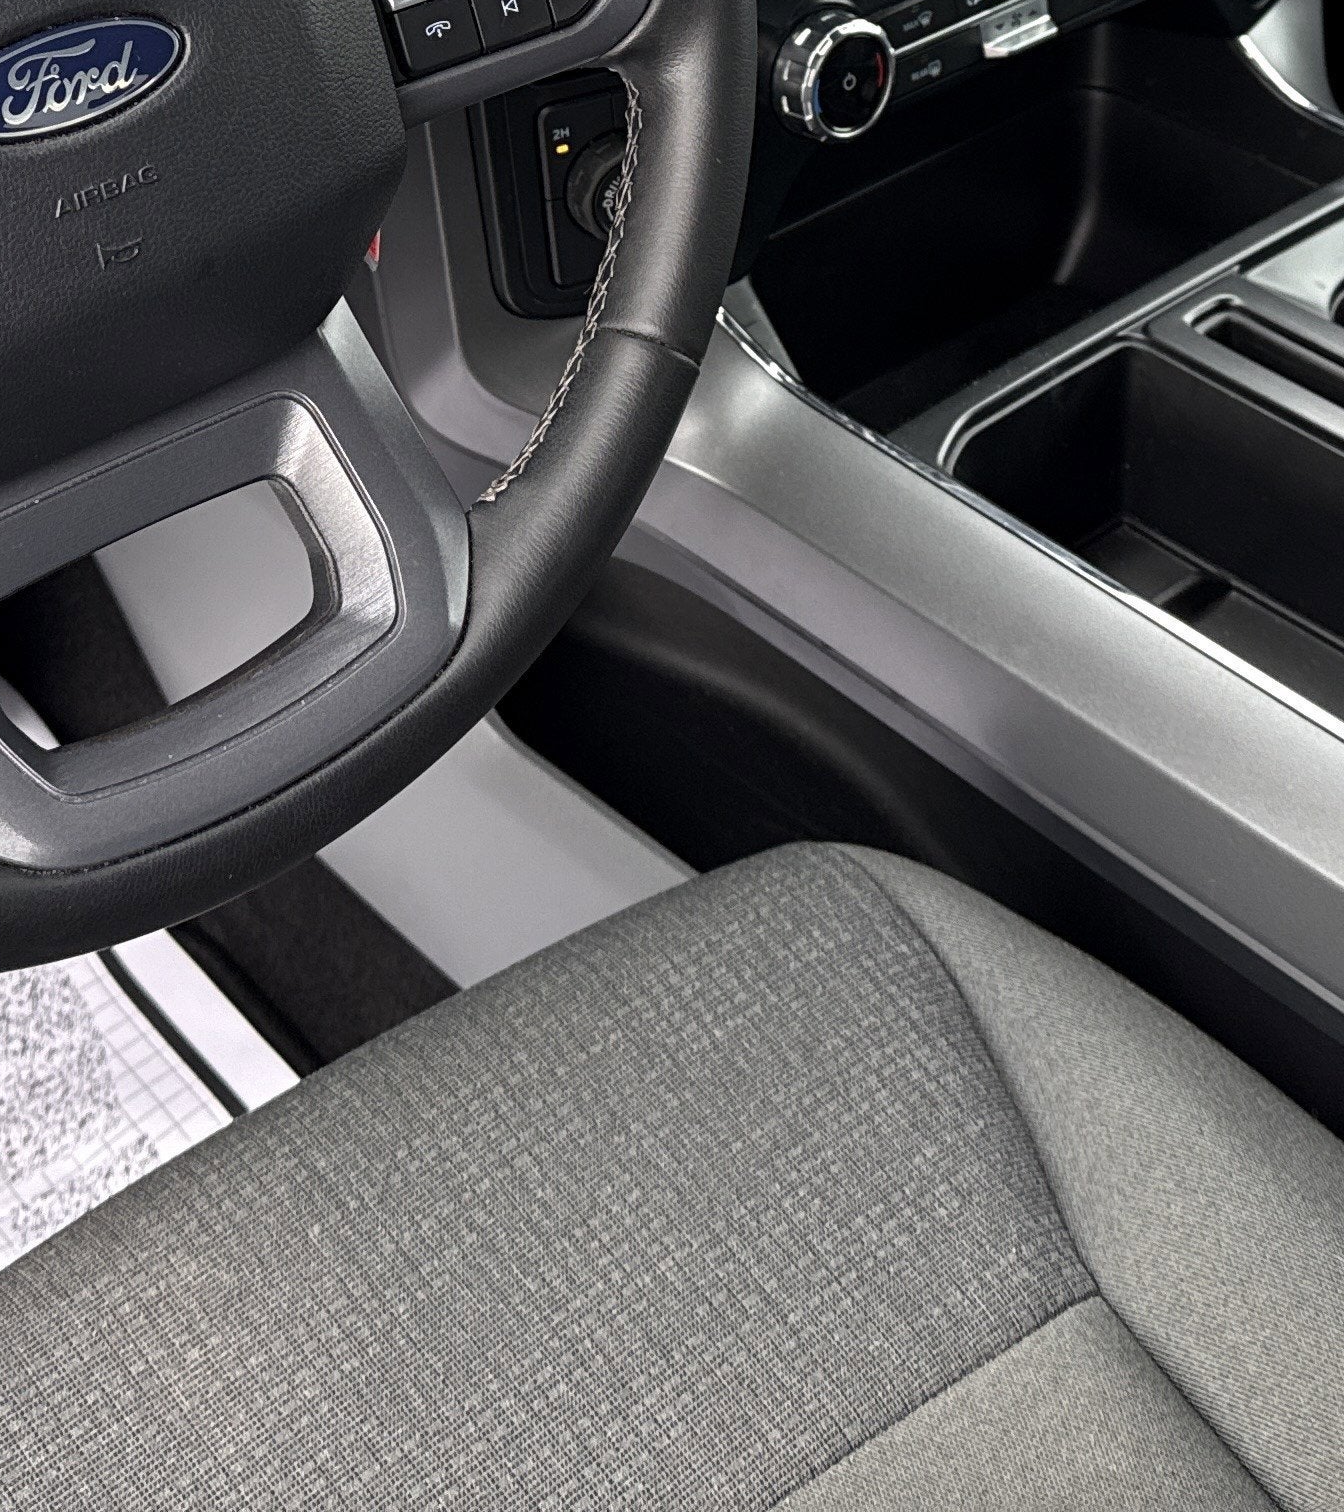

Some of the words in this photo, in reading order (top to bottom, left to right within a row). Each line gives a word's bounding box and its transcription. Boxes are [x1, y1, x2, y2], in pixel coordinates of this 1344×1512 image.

[1, 38, 138, 126] Ford
[552, 126, 571, 141] 2H
[55, 163, 158, 219] AIRBAG
